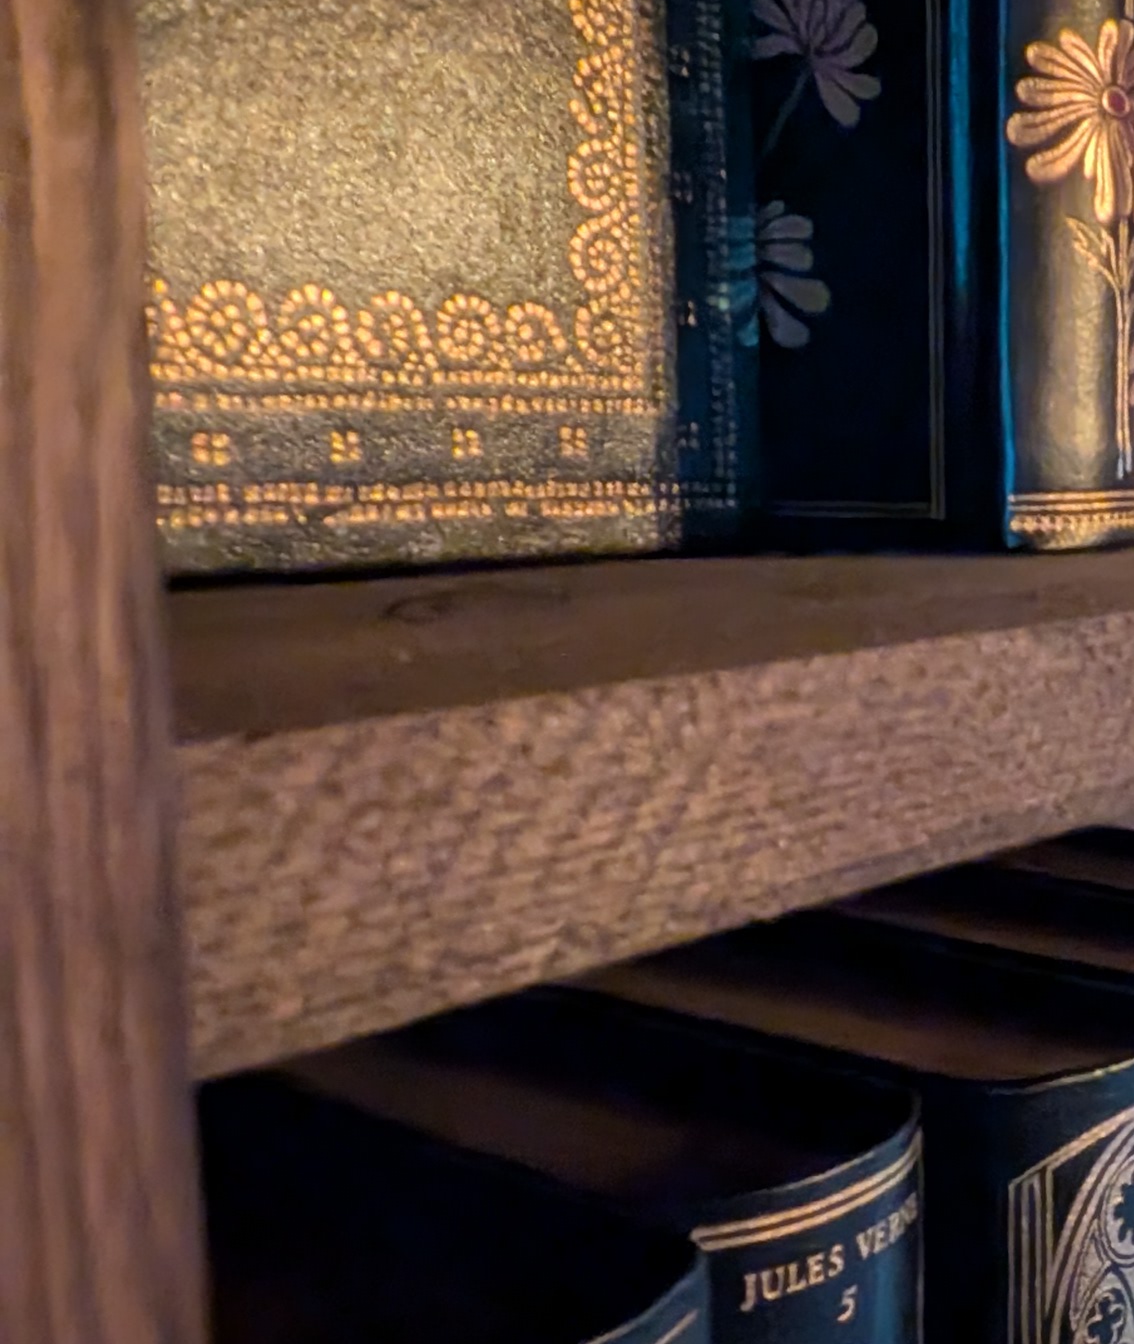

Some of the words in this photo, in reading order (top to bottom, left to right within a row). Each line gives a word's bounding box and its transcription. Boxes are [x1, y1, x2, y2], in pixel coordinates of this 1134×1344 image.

[739, 1243, 845, 1312] JULES
[856, 1191, 918, 1261] VERN
[838, 1284, 858, 1323] 5
